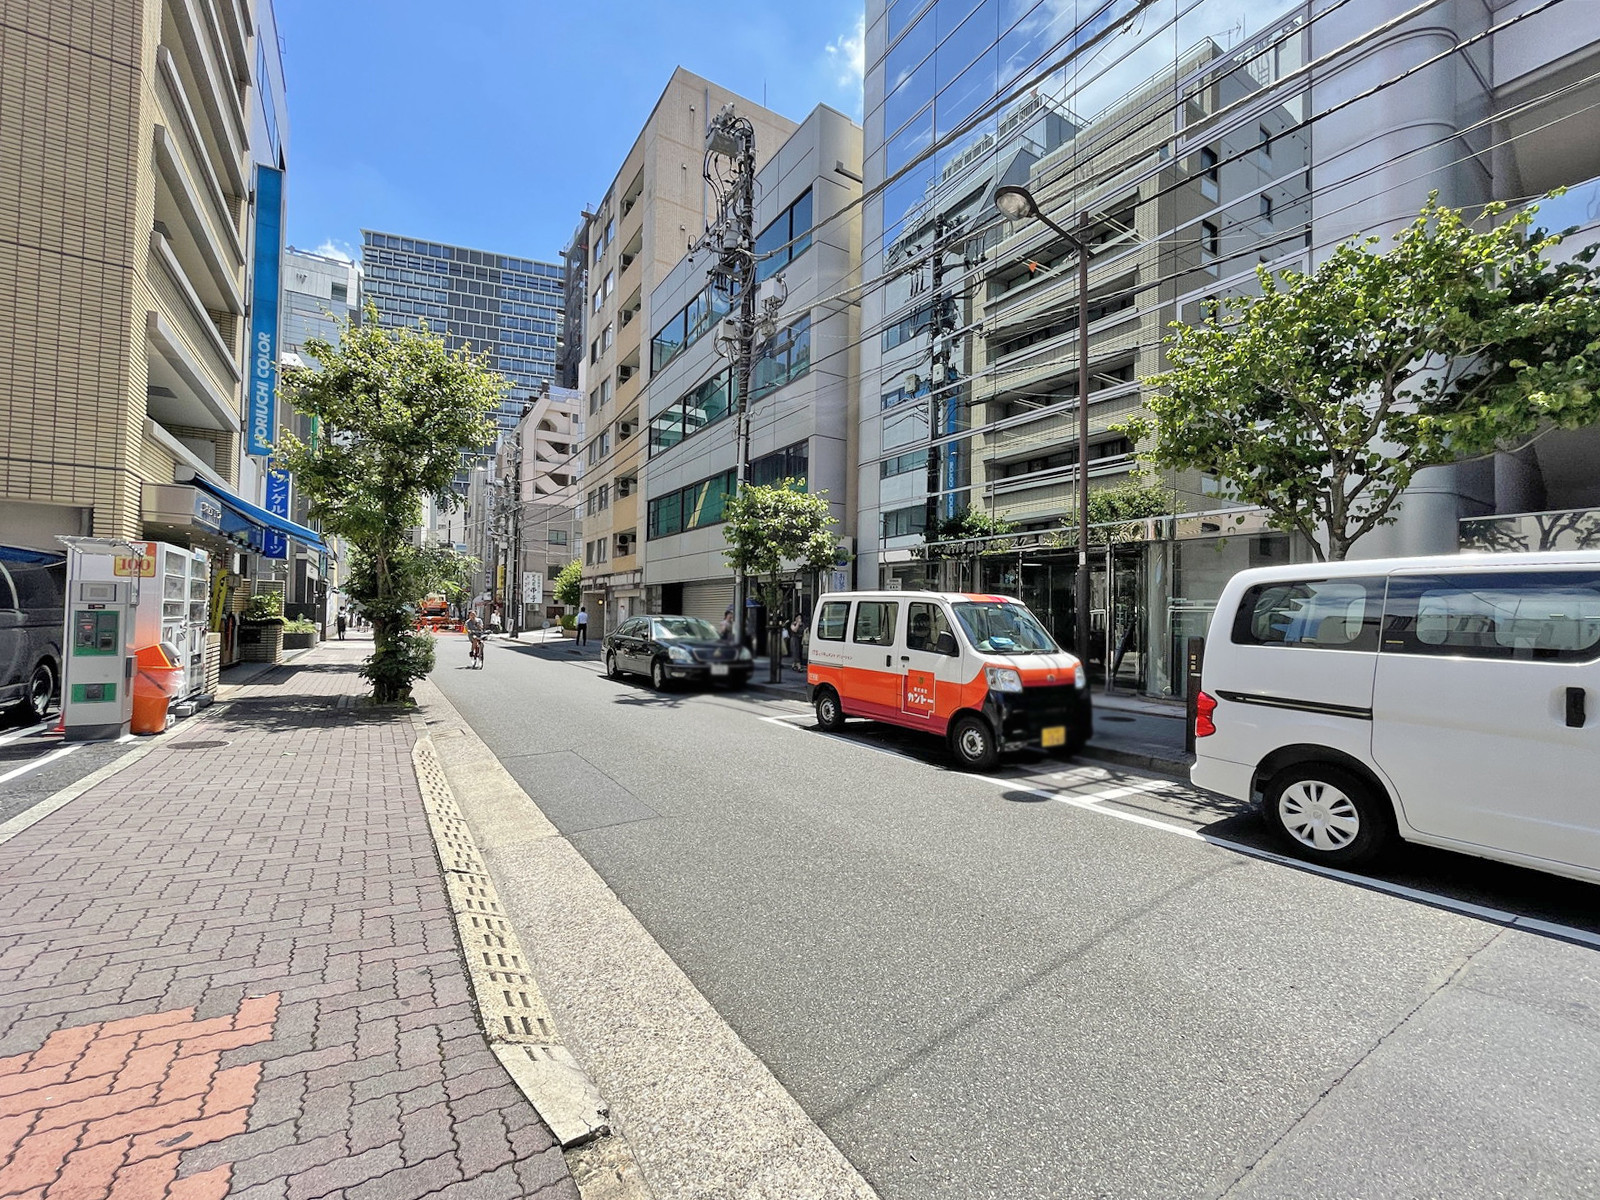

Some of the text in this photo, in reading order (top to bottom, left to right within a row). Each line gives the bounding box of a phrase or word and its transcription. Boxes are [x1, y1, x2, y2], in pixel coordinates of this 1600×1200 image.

[254, 331, 271, 449] HORIUCHI COLOR
[120, 558, 151, 571] 100
